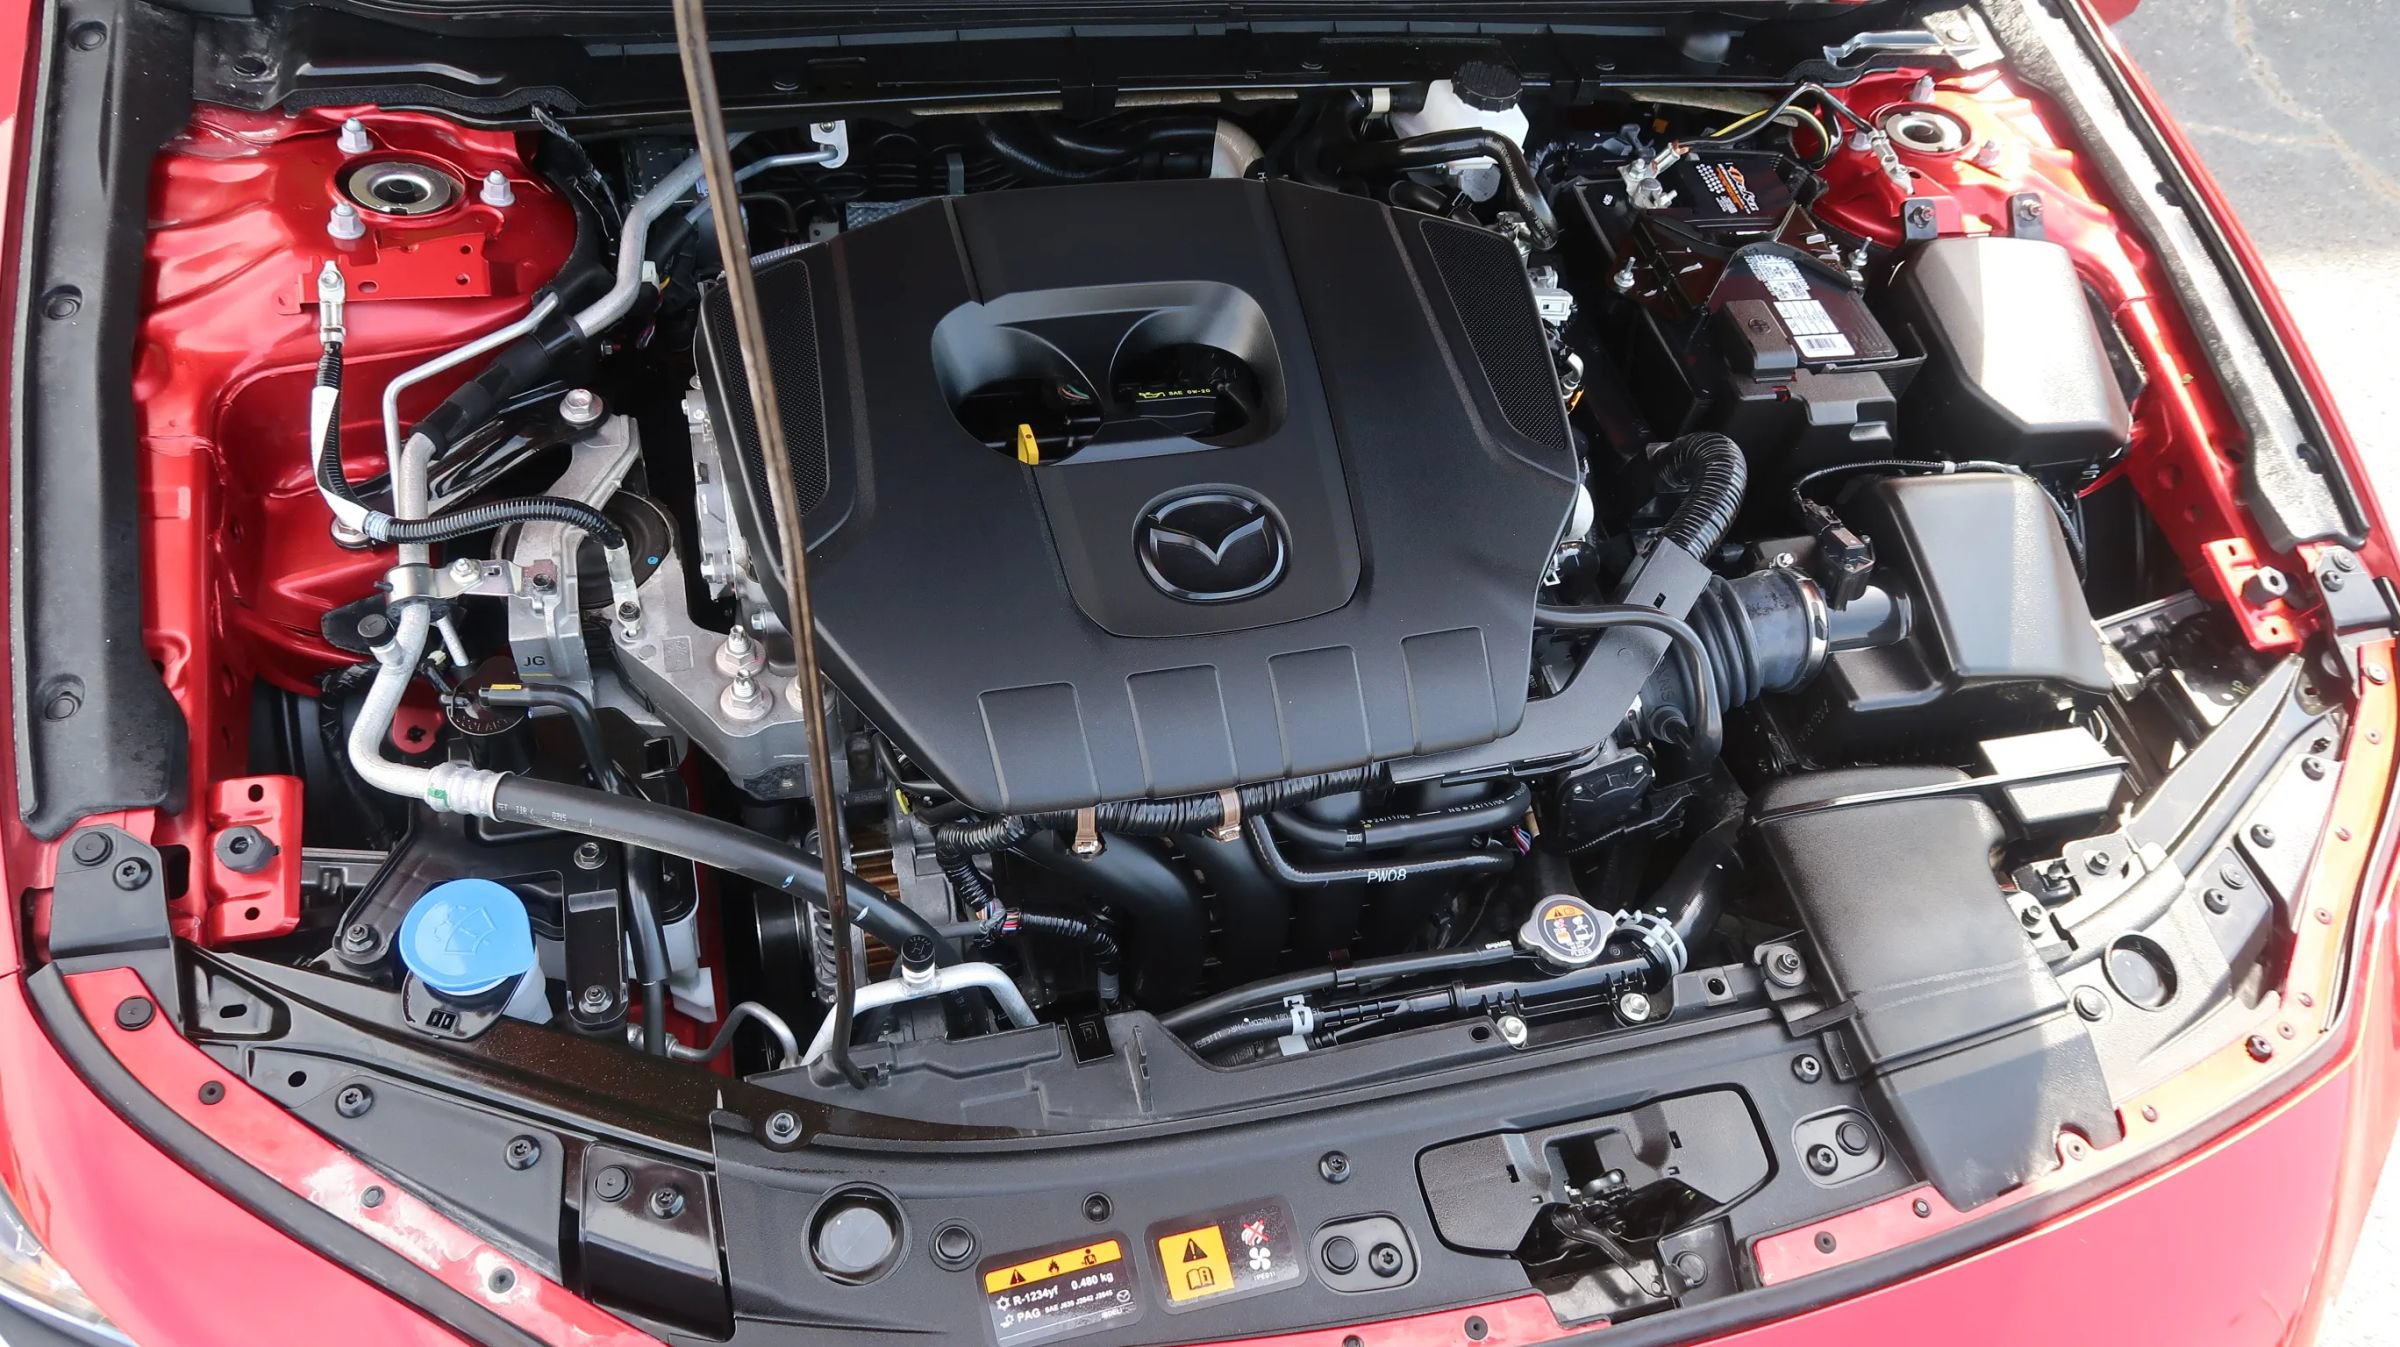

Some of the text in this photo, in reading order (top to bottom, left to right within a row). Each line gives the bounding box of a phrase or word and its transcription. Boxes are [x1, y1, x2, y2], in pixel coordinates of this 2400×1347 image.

[523, 655, 546, 667] JG
[1367, 868, 1408, 884] PW08
[1012, 1271, 1114, 1307] R-1234yf 0.480 kg
[1016, 1307, 1042, 1323] PAG
[1045, 1303, 1059, 1313] SAE
